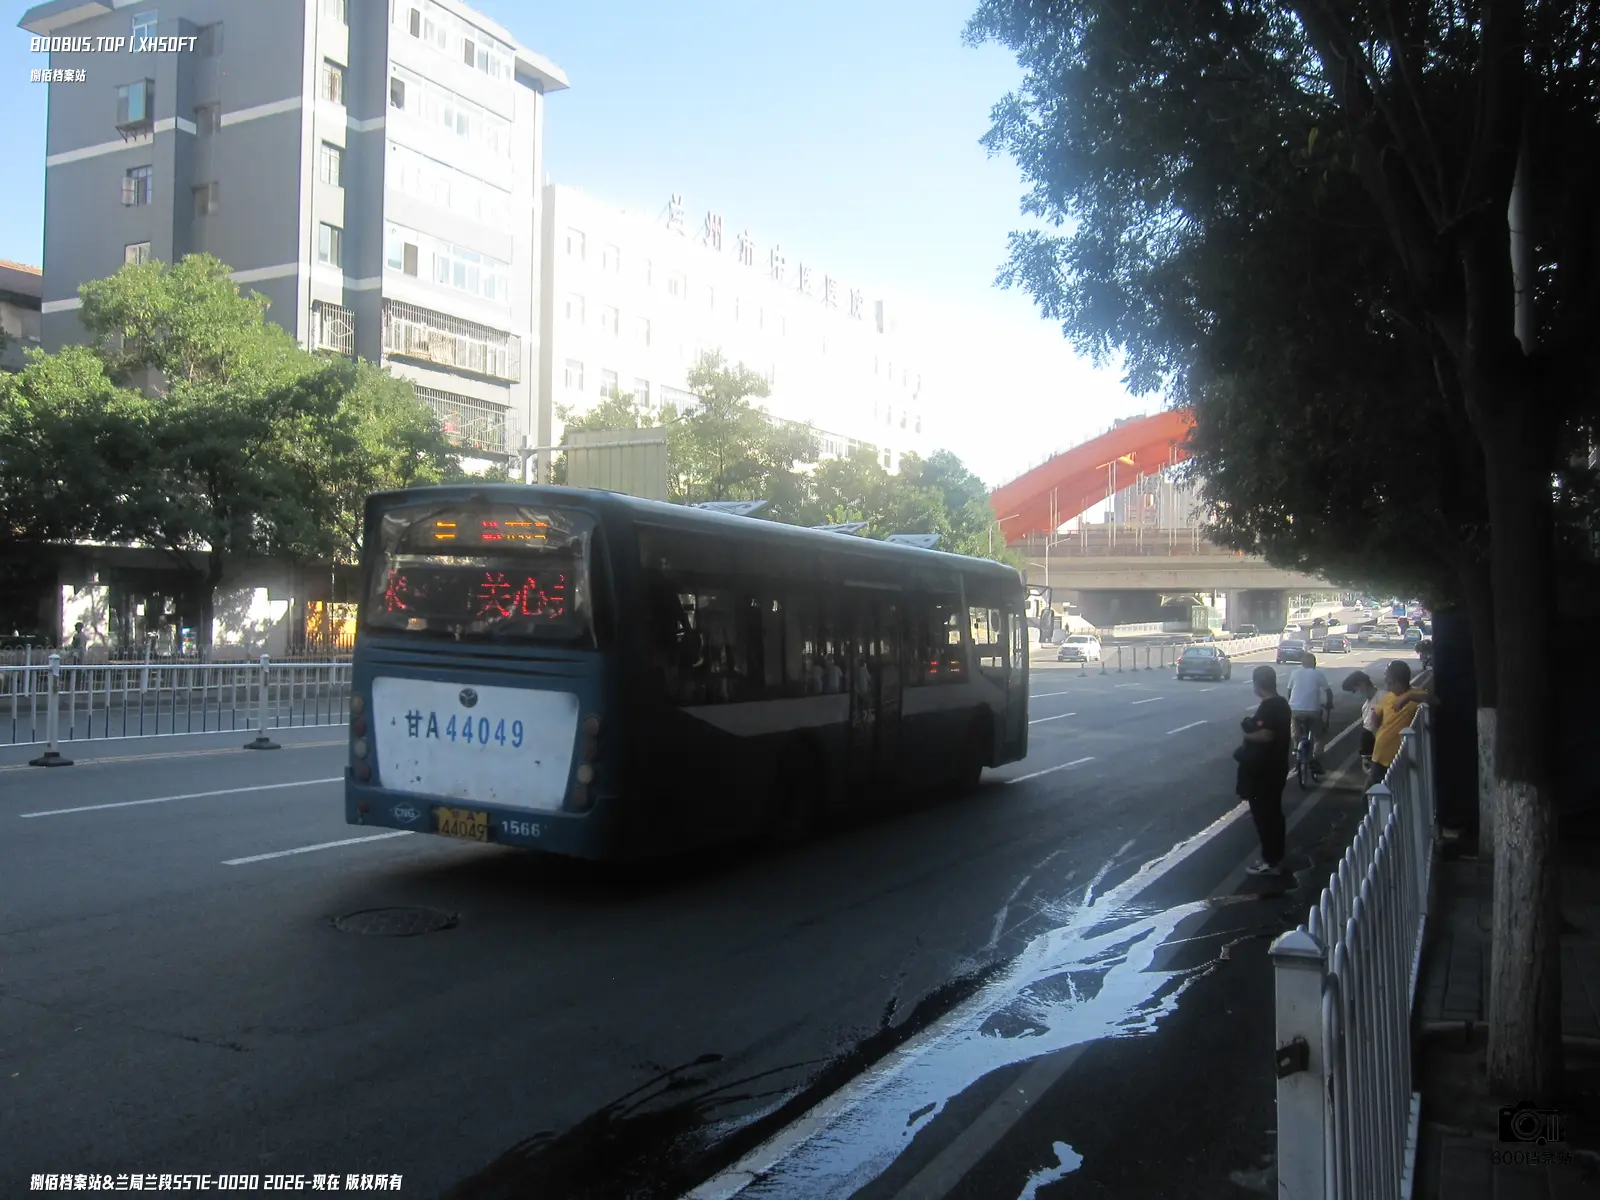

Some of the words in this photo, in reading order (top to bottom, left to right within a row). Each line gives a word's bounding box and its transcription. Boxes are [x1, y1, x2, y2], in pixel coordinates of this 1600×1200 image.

[405, 709, 525, 748] 甘A44049
[440, 819, 486, 841] 44049
[501, 820, 542, 838] 1566
